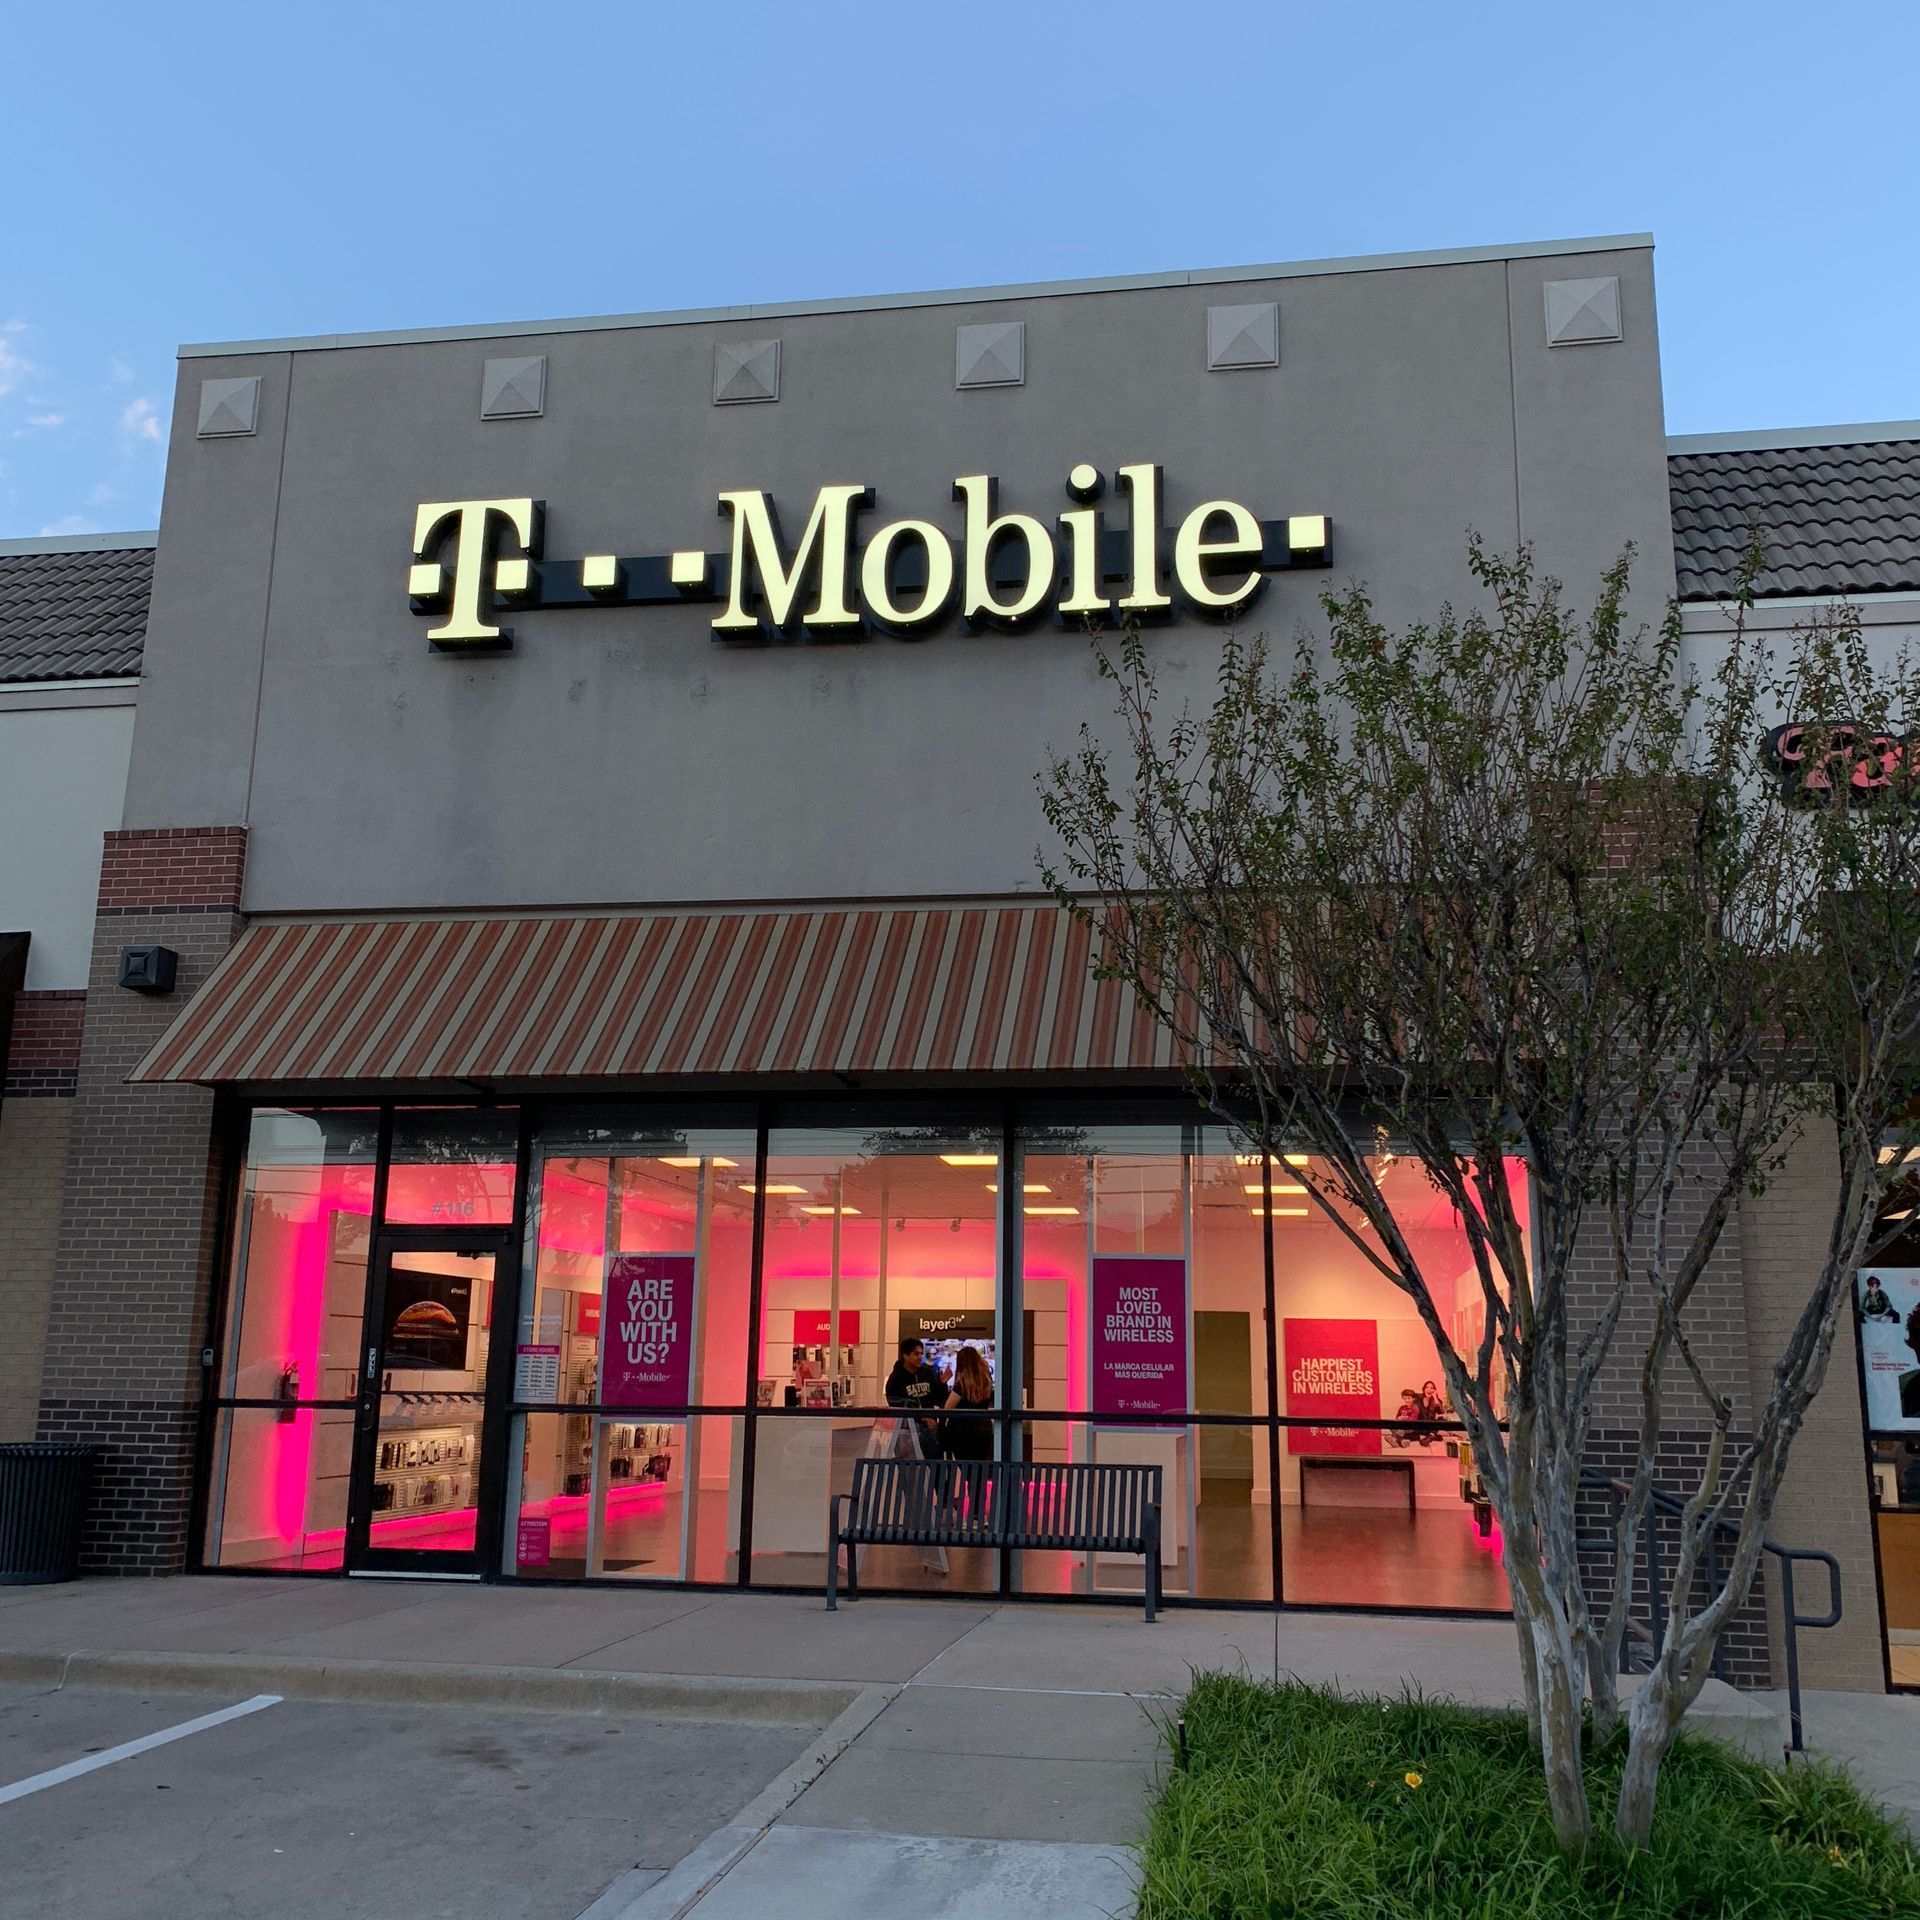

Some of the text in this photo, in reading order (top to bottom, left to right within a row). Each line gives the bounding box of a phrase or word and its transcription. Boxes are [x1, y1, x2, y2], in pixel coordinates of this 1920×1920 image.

[431, 1200, 475, 1217] #116
[627, 1279, 674, 1300] ARE
[1119, 1287, 1158, 1301] MOST
[626, 1300, 673, 1322] YOU
[1116, 1301, 1162, 1315] LOVED
[816, 1323, 831, 1331] AUD
[1106, 1315, 1172, 1329] BRAND IN
[620, 1321, 677, 1343] WITH
[1104, 1328, 1174, 1344] WIRELESS
[627, 1342, 670, 1365] US?
[1104, 1362, 1174, 1372] LA MARCA CELULAR
[1301, 1357, 1363, 1371] HAPPIEST
[1131, 1371, 1164, 1380] QUERIDA
[1292, 1369, 1374, 1384] CUSTOMERS
[1293, 1381, 1374, 1396] IN WIRELESS
